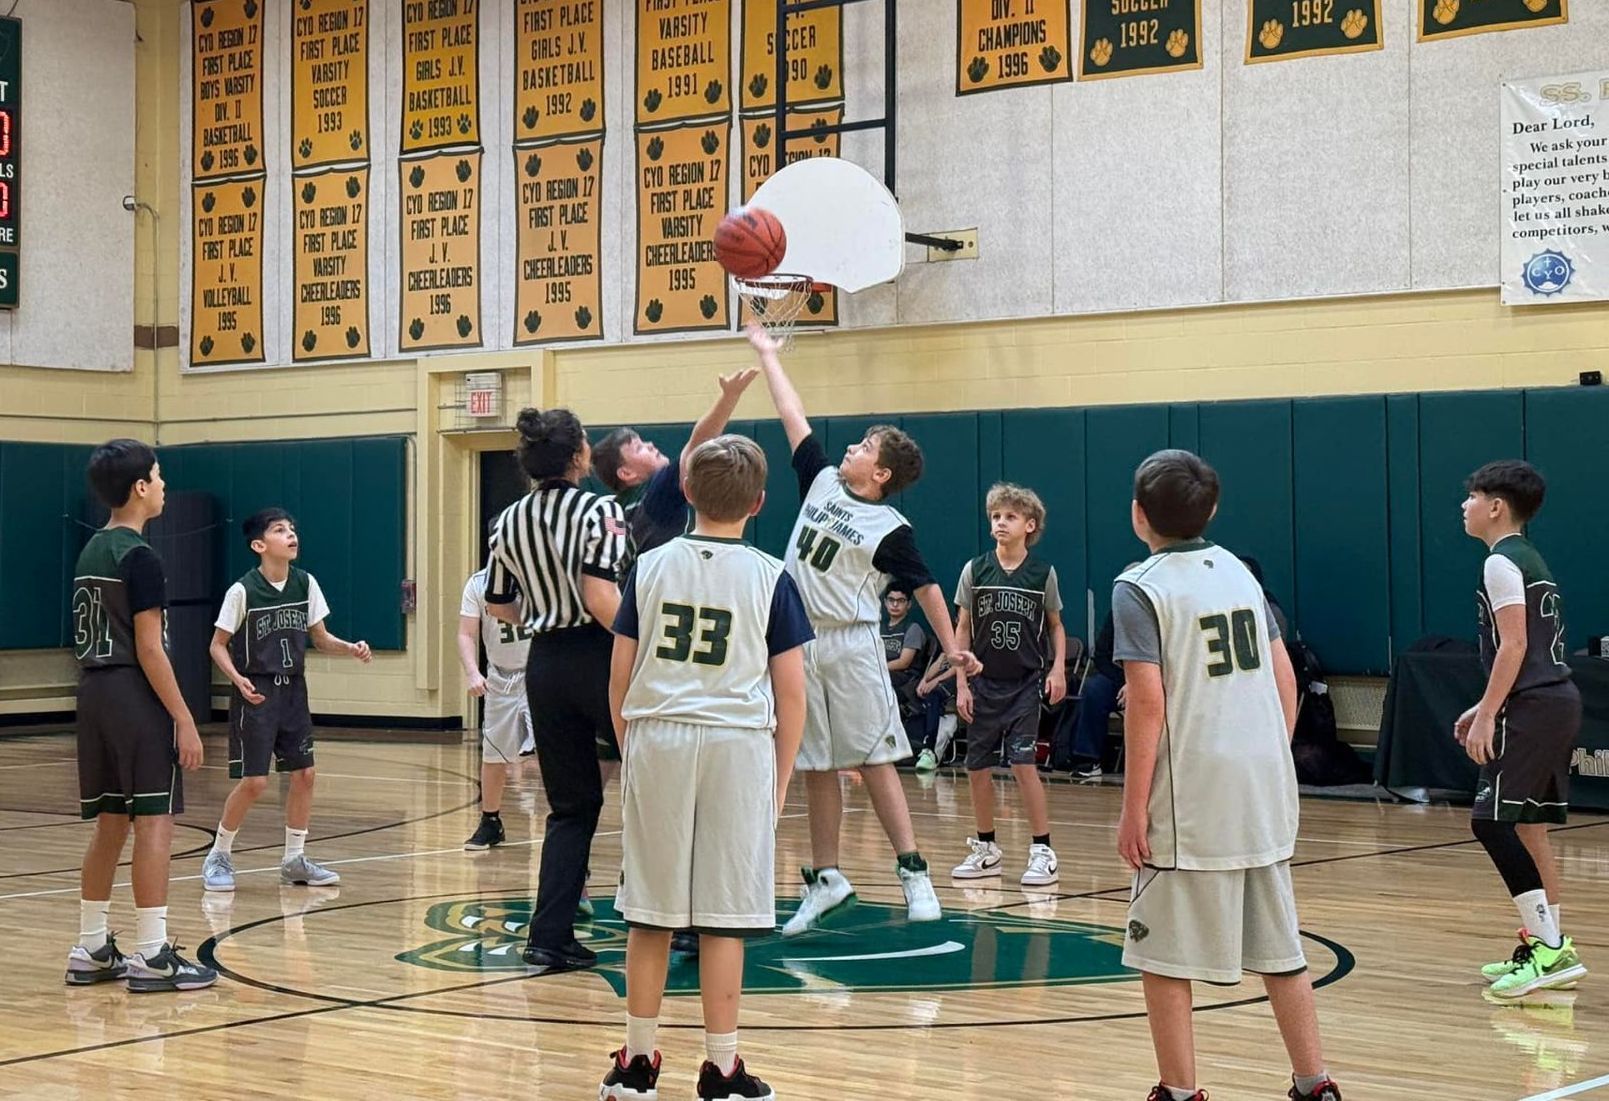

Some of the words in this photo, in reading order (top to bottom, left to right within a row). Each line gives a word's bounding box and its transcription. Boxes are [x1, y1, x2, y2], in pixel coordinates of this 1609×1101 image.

[297, 15, 314, 37] CYO
[318, 10, 349, 33] REGION
[353, 7, 364, 27] 17
[406, 3, 424, 24] CYO
[524, 9, 553, 33] FIRST
[560, 1, 594, 27] PLACE
[659, 11, 708, 40] VARSITY
[1292, 0, 1333, 28] 1992
[199, 33, 213, 53] CYO
[218, 28, 244, 49] REGION
[248, 25, 258, 44] 17
[409, 30, 435, 53] FIRST
[441, 24, 472, 47] PLACE
[767, 25, 816, 55] SCCER
[978, 20, 1047, 52] CHAMPIONS
[1120, 19, 1159, 48] 1992
[300, 39, 326, 61] FIRST
[332, 33, 360, 56] PLACE
[531, 36, 561, 61] GIRLS
[651, 41, 714, 71] BASEBALL
[202, 54, 224, 76] FIRST
[228, 50, 254, 71] PLACE
[312, 60, 350, 84] VARSITY
[416, 59, 442, 81] GIRLS
[523, 60, 595, 91] BASKETBALL
[997, 52, 1029, 79] 1996
[201, 79, 220, 100] BOYS
[224, 74, 255, 96] VARSITY
[313, 86, 347, 109] SOCCER
[668, 72, 698, 98] 1991
[409, 84, 472, 112] BASKETBALL
[546, 92, 572, 116] 1992
[215, 102, 230, 122] DIV.
[317, 111, 342, 133] 1993
[1512, 121, 1547, 135] Dear
[1552, 114, 1595, 130] Lord,
[203, 123, 253, 147] BASKETBALL
[428, 115, 452, 138] 1993
[1530, 142, 1549, 153] We
[1551, 138, 1573, 151] ask
[1576, 137, 1608, 152] your
[219, 148, 239, 169] 1996
[750, 154, 770, 178] CYO
[1512, 157, 1558, 175] special
[1562, 154, 1608, 167] talents
[644, 165, 663, 188] CYO
[669, 161, 704, 185] REGION
[709, 159, 721, 182] 17
[1512, 177, 1541, 191] play
[1544, 175, 1567, 186] our
[1570, 172, 1600, 185] very
[406, 194, 423, 215] CYO
[427, 190, 458, 212] REGION
[463, 188, 474, 209] 17
[523, 183, 541, 204] CYO
[546, 178, 578, 201] REGION
[583, 176, 595, 197] 17
[651, 190, 678, 214] FIRST
[683, 187, 714, 210] PLACE
[1512, 193, 1565, 208] players,
[1569, 187, 1609, 201] coach
[199, 217, 213, 237] CYO
[218, 214, 244, 235] REGION
[248, 212, 258, 232] 17
[300, 209, 315, 230] CYO
[319, 206, 347, 227] REGION
[351, 204, 362, 224] 17
[529, 206, 555, 229] FIRST
[559, 202, 588, 226] PLACE
[661, 214, 703, 239] VARSITY
[1514, 211, 1531, 222] let
[1534, 211, 1550, 220] us
[1554, 207, 1571, 219] all
[411, 218, 437, 240] FIRST
[441, 215, 469, 236] PLACE
[1512, 224, 1598, 240] competitors,
[202, 240, 224, 261] FIRST
[228, 237, 254, 258] PLACE
[303, 233, 326, 253] FIRST
[331, 229, 357, 251] PLACE
[313, 255, 347, 277] VARSITY
[408, 266, 473, 291] CHEERLEADERS
[524, 254, 593, 280] CHEERLEADERS
[301, 280, 361, 304] CHEERLEADERS
[668, 268, 696, 291] 1995
[203, 286, 252, 309] VOLLEYBALL
[429, 294, 451, 315] 1996
[545, 282, 571, 304] 1995
[217, 311, 237, 331] 1995
[320, 305, 341, 326] 1996
[471, 391, 492, 413] EXIT
[823, 501, 854, 522] SAINTS
[796, 525, 842, 573] 40
[994, 591, 1037, 621] JOSEPH
[73, 586, 113, 660] 31
[655, 602, 732, 667] 33
[991, 621, 1021, 650] 35
[280, 638, 293, 668] 1
[1199, 608, 1261, 678] 30
